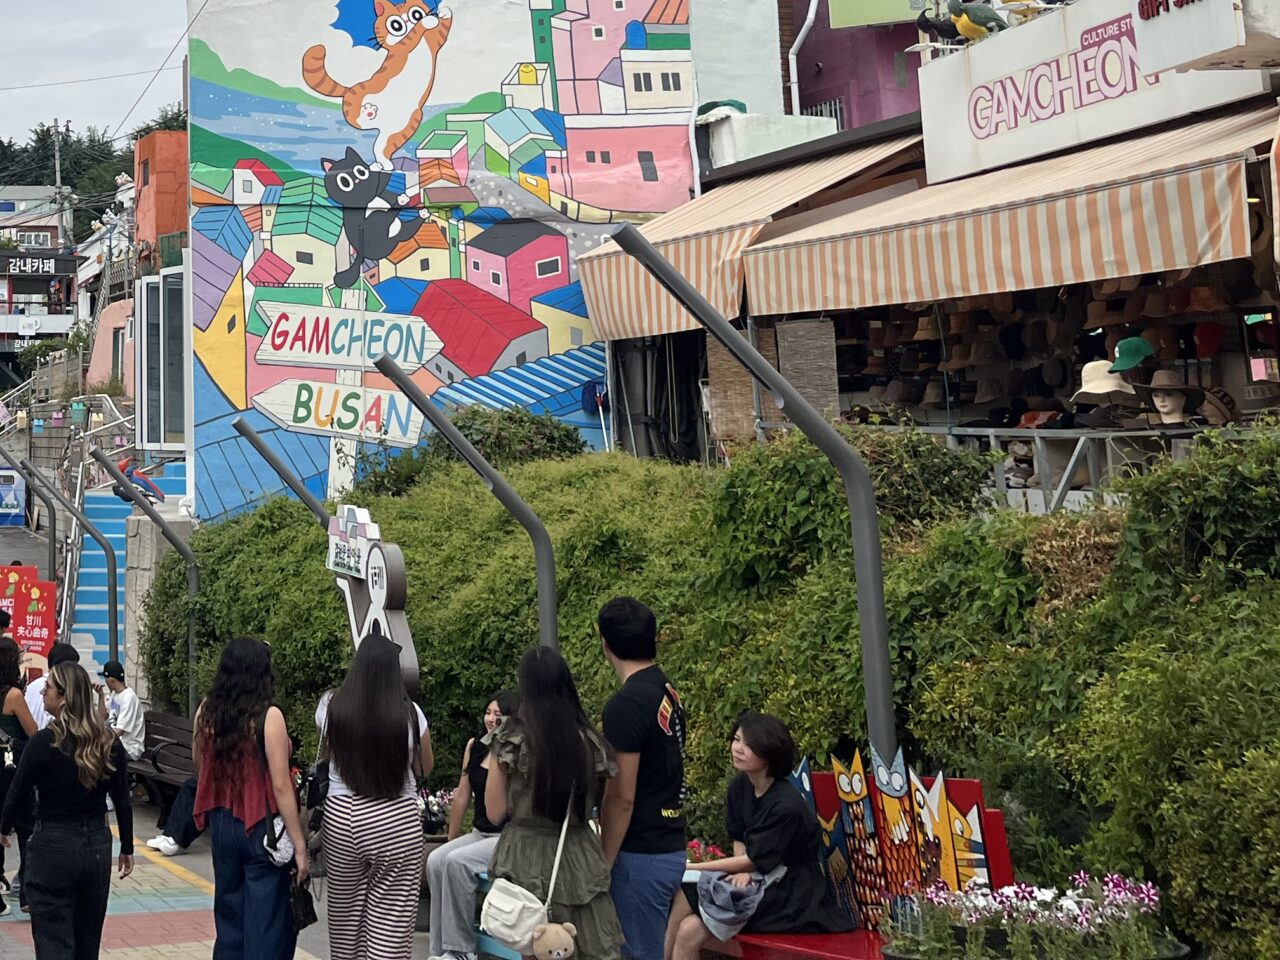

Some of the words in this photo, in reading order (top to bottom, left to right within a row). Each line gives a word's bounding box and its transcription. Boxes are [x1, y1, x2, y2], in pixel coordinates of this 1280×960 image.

[1082, 24, 1120, 46] CULTURE
[1121, 20, 1133, 32] ST
[968, 35, 1160, 140] GAMCHEON
[9, 257, 55, 274] 감내카페
[271, 312, 426, 364] GAMCHEON
[292, 383, 413, 438] BUSAN
[26, 614, 42, 627] 甘川
